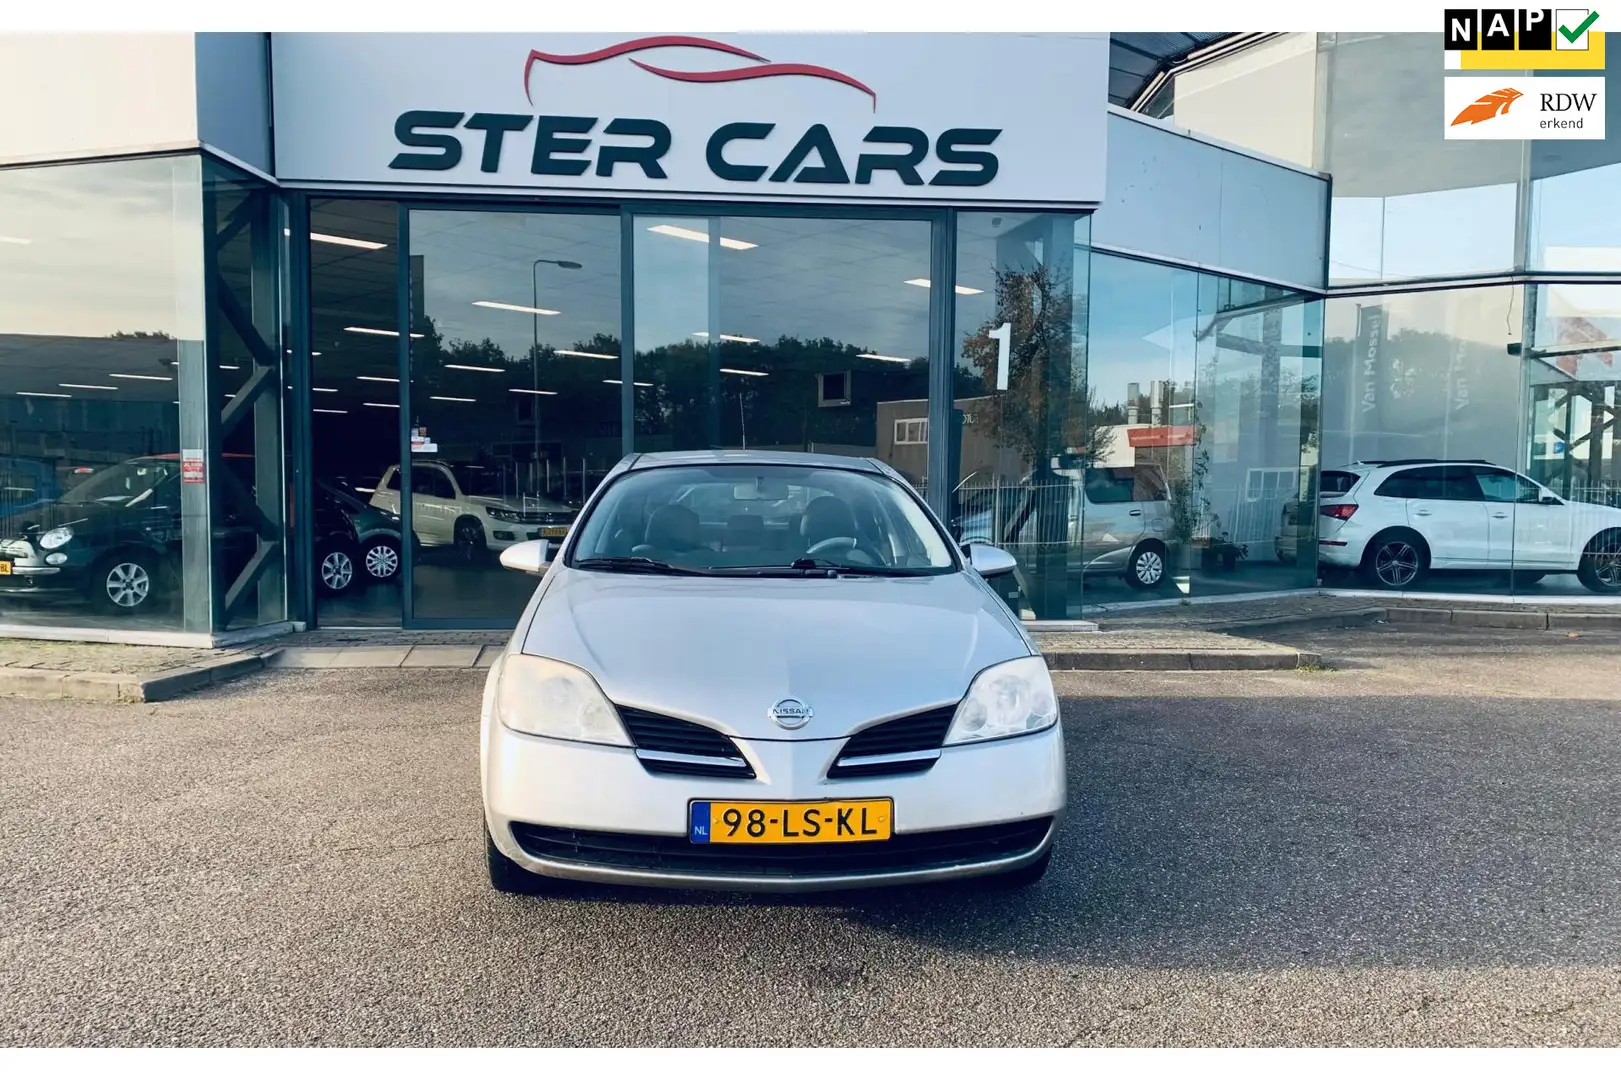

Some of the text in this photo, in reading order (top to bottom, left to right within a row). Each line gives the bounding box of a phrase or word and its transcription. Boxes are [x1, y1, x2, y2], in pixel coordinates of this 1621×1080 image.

[388, 109, 1003, 187] STER CARS
[988, 322, 1012, 391] 1
[1361, 381, 1377, 413] Van
[694, 825, 708, 836] NL
[722, 807, 878, 838] 98-LS-KL
